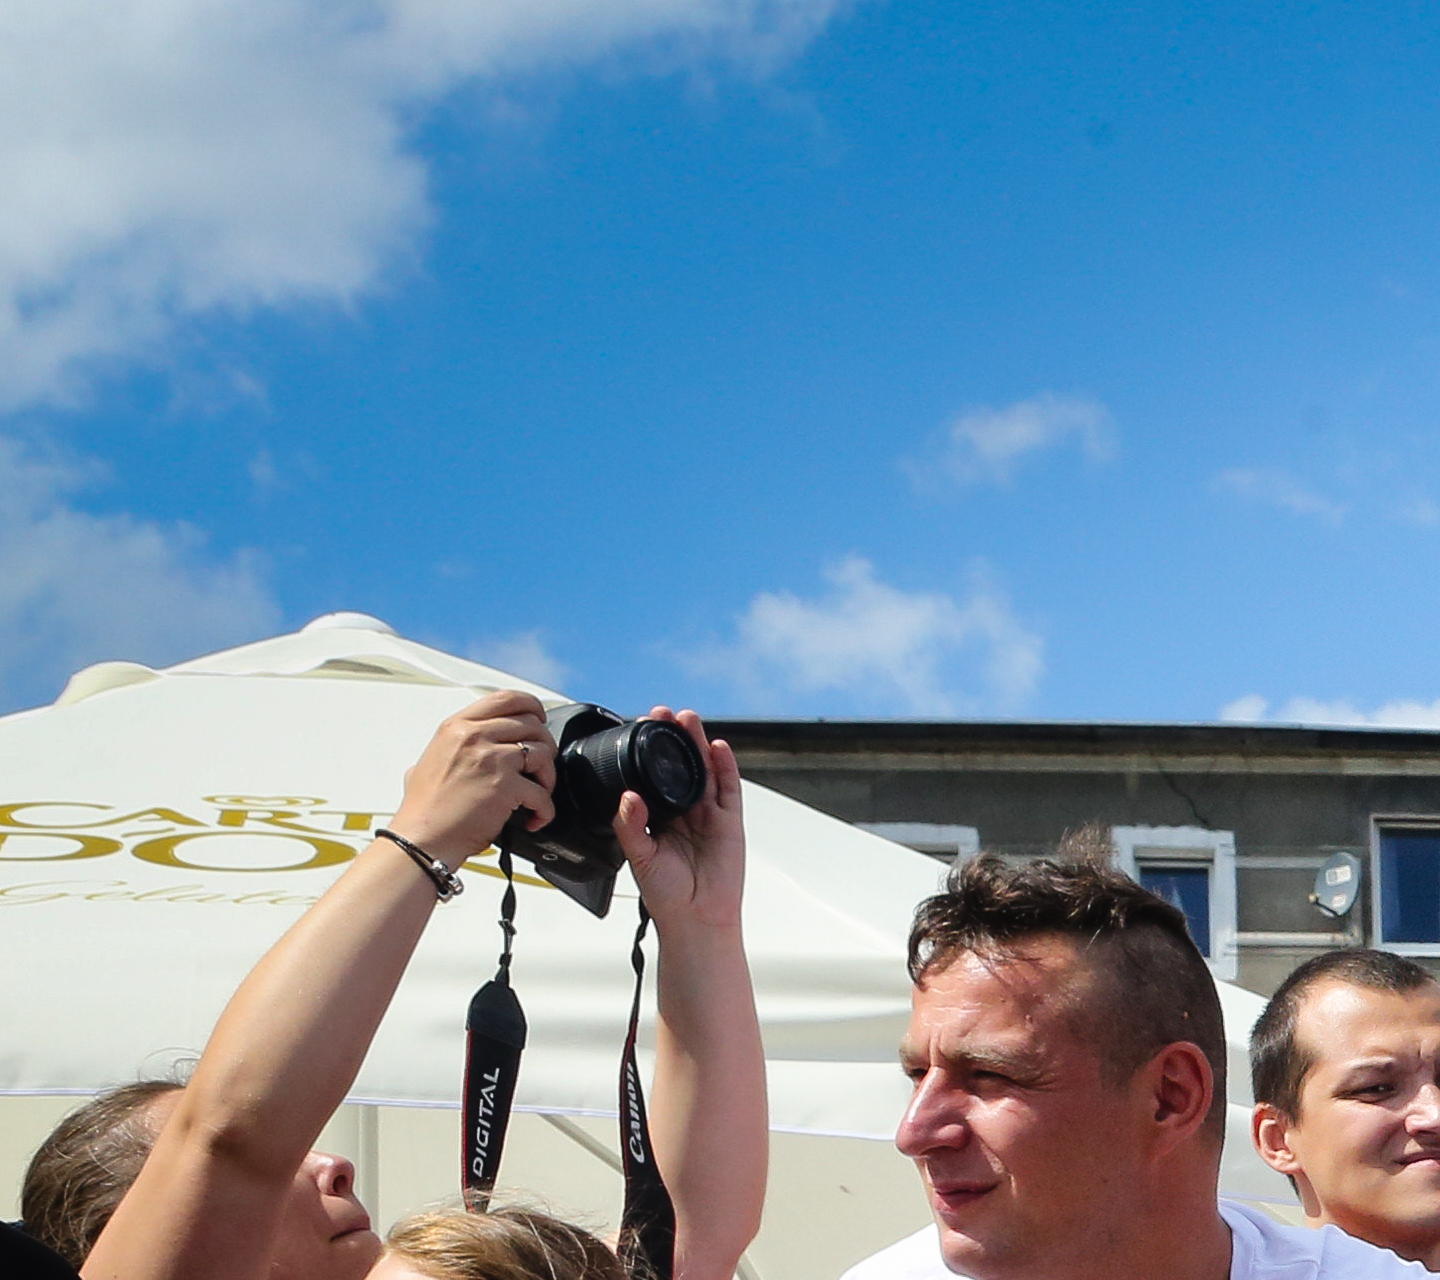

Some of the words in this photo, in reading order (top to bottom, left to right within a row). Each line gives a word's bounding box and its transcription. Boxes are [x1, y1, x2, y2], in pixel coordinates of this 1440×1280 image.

[0, 800, 396, 836] CART
[473, 1066, 500, 1178] DIGITAL
[627, 1061, 645, 1164] Canon
